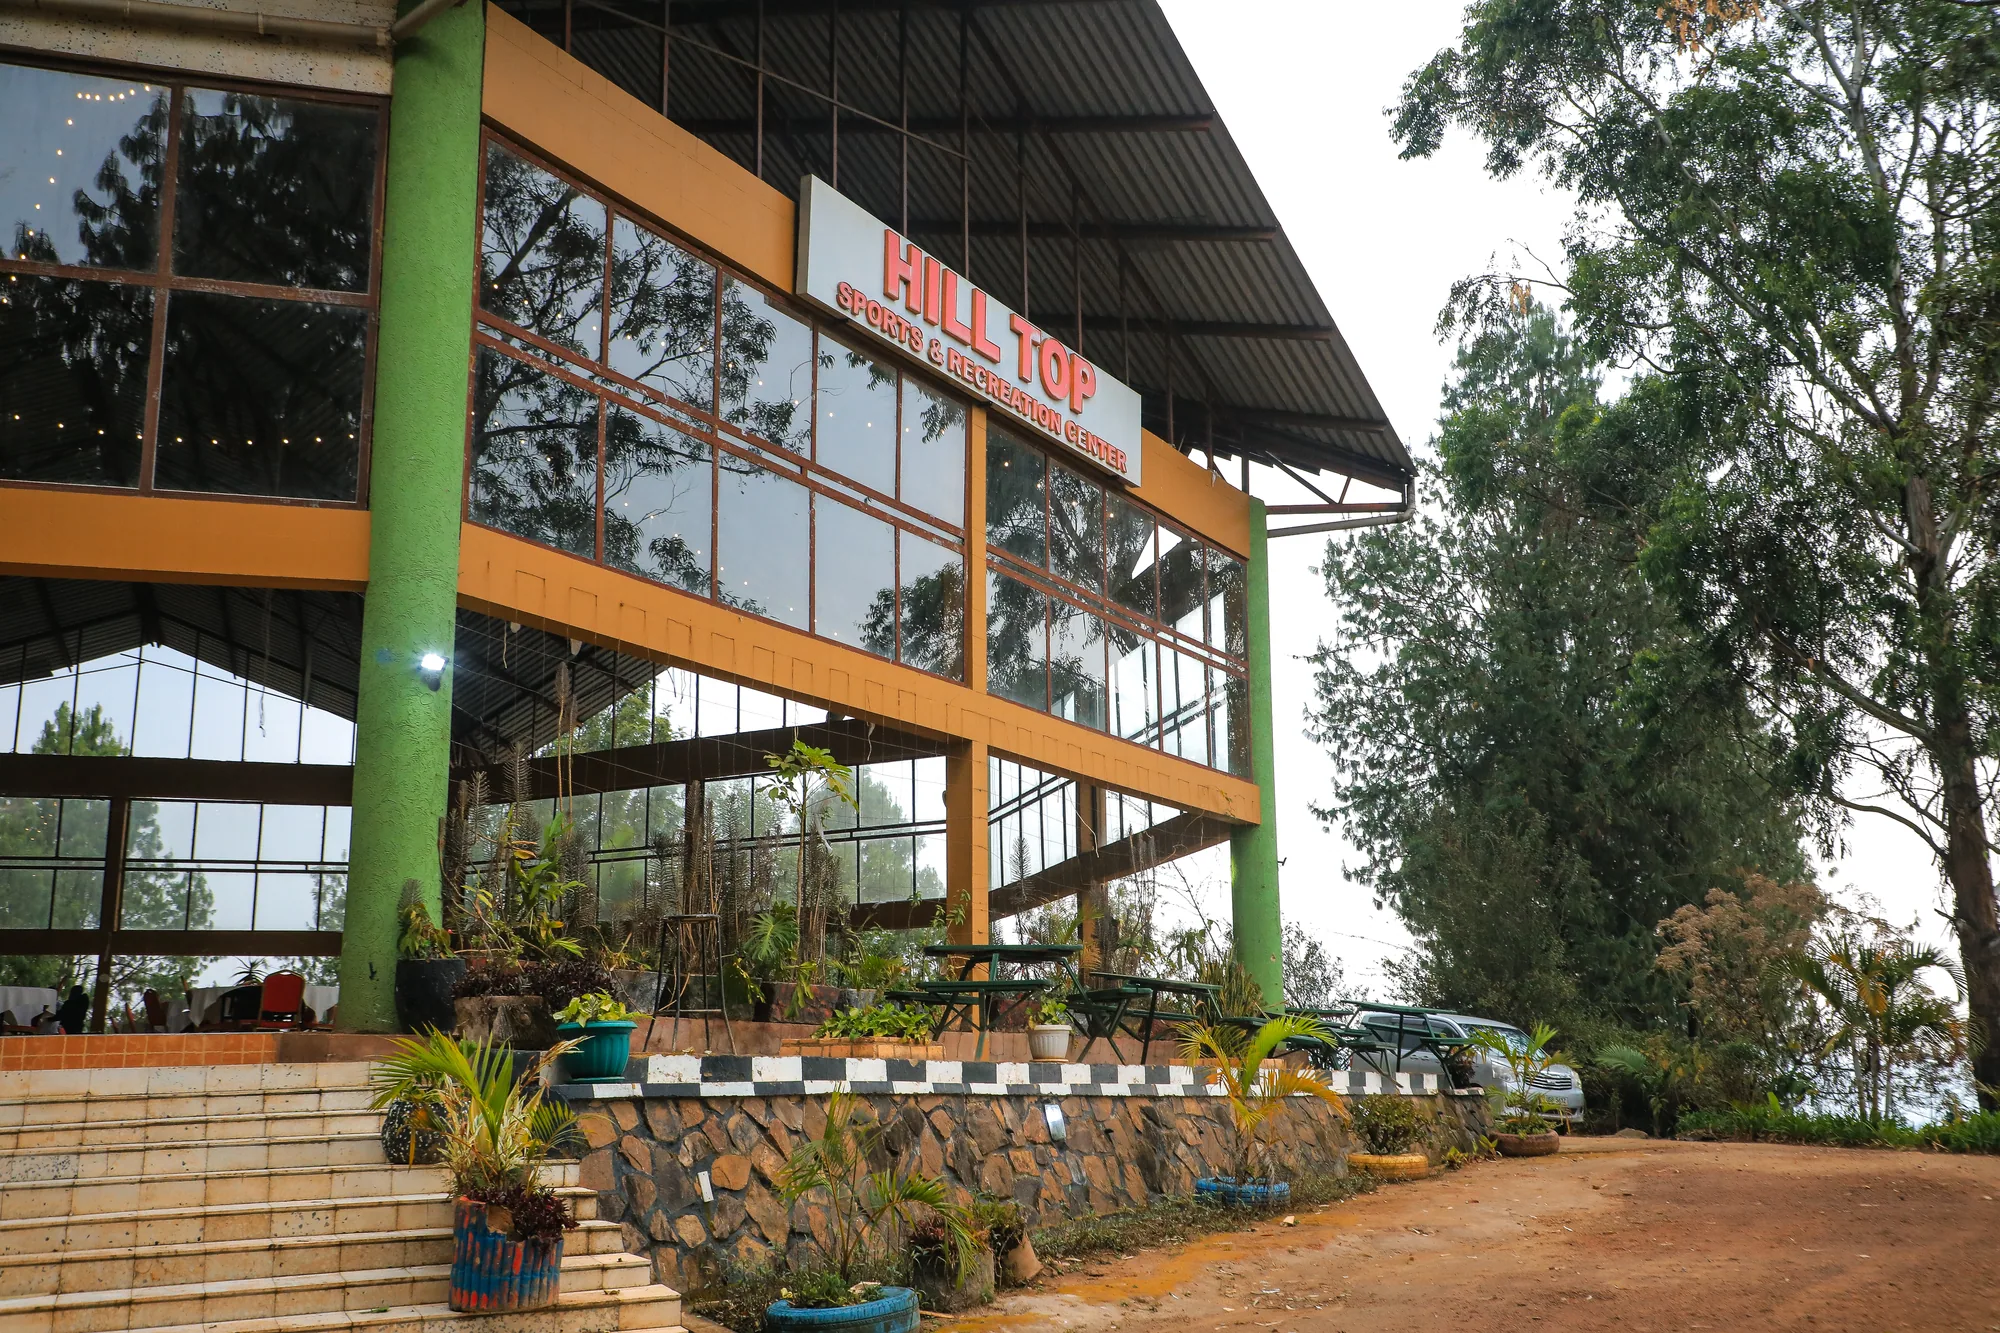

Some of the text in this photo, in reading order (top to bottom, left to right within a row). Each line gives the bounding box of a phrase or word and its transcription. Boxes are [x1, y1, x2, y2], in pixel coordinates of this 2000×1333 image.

[836, 281, 1127, 473] SPORTS & RECREATION CENTER
[883, 229, 1096, 414] HILL TOP
